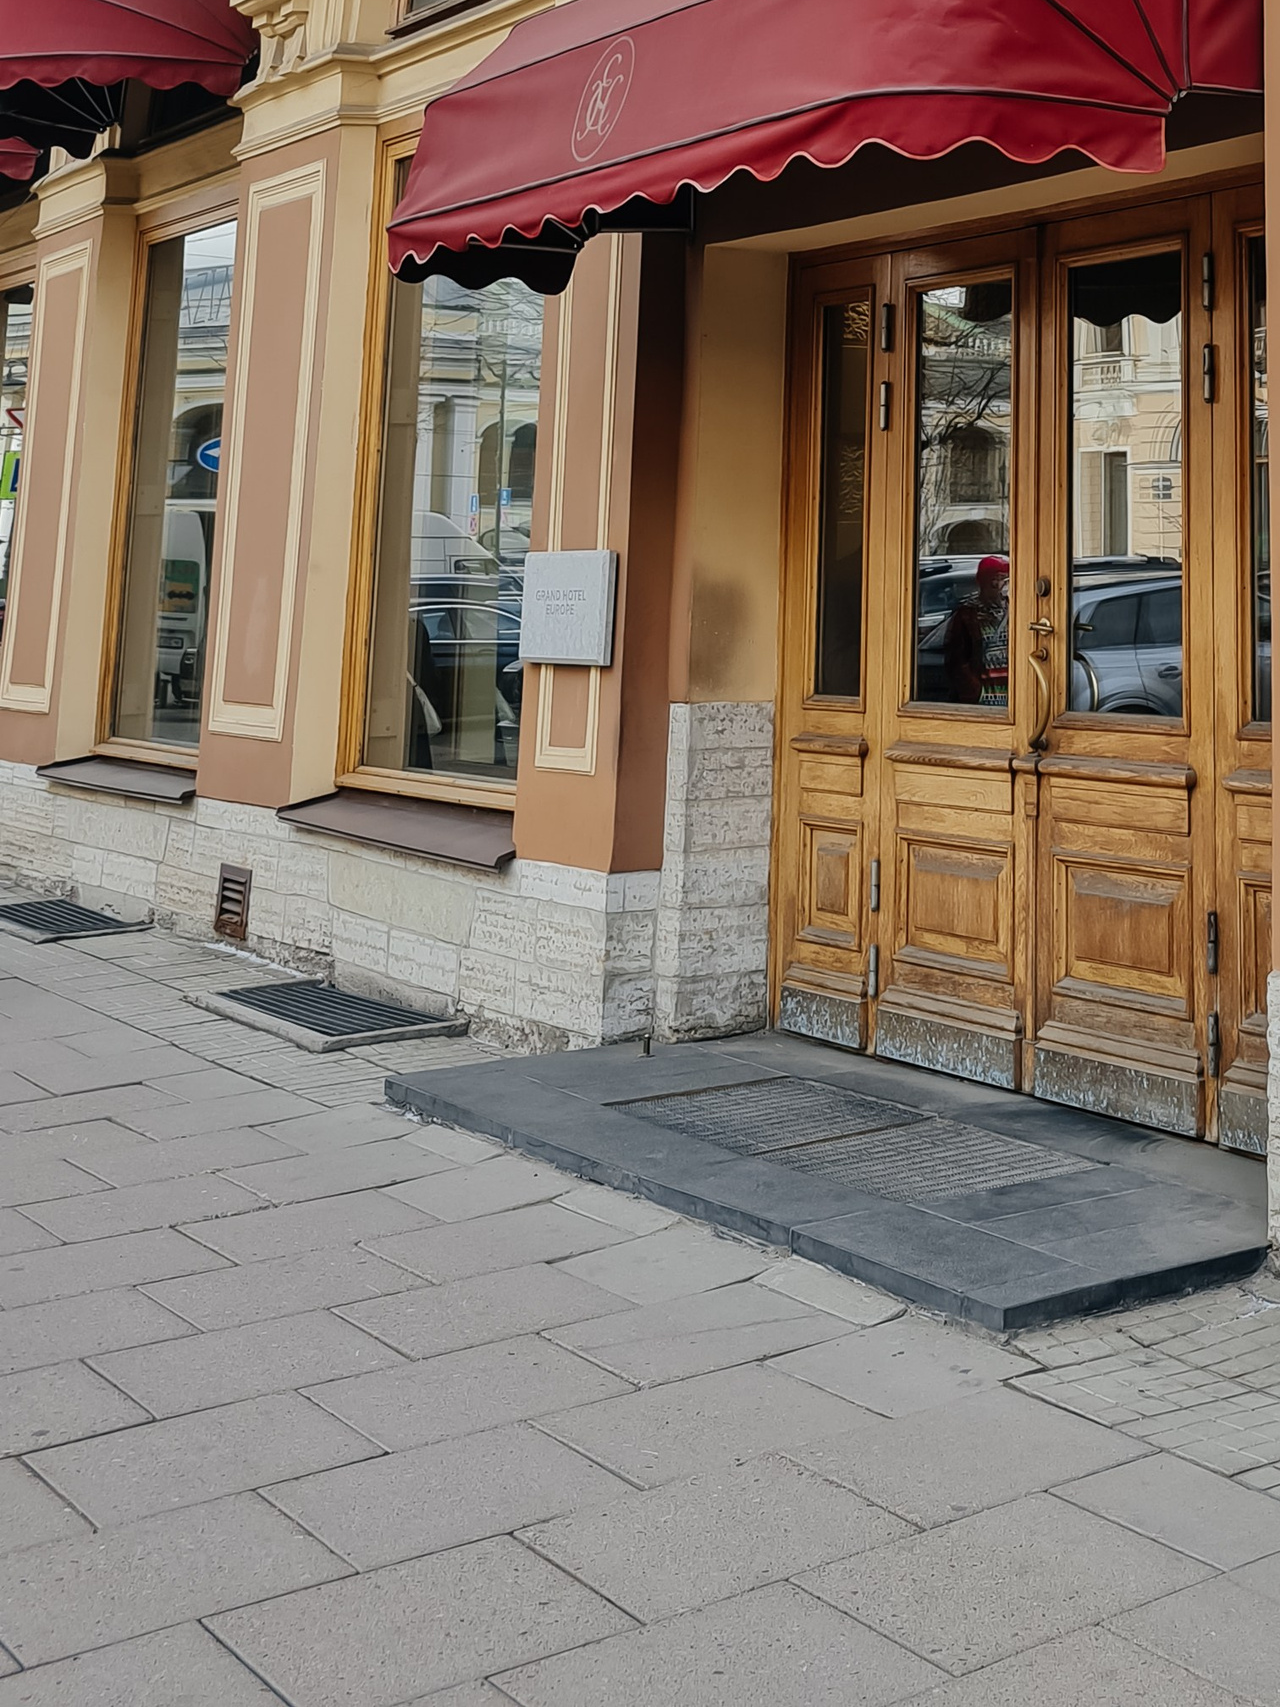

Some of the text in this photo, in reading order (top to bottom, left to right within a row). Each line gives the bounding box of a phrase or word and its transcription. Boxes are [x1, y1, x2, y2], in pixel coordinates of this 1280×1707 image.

[535, 589, 586, 601] GRAND HOTEL
[545, 603, 575, 615] EUROPE
